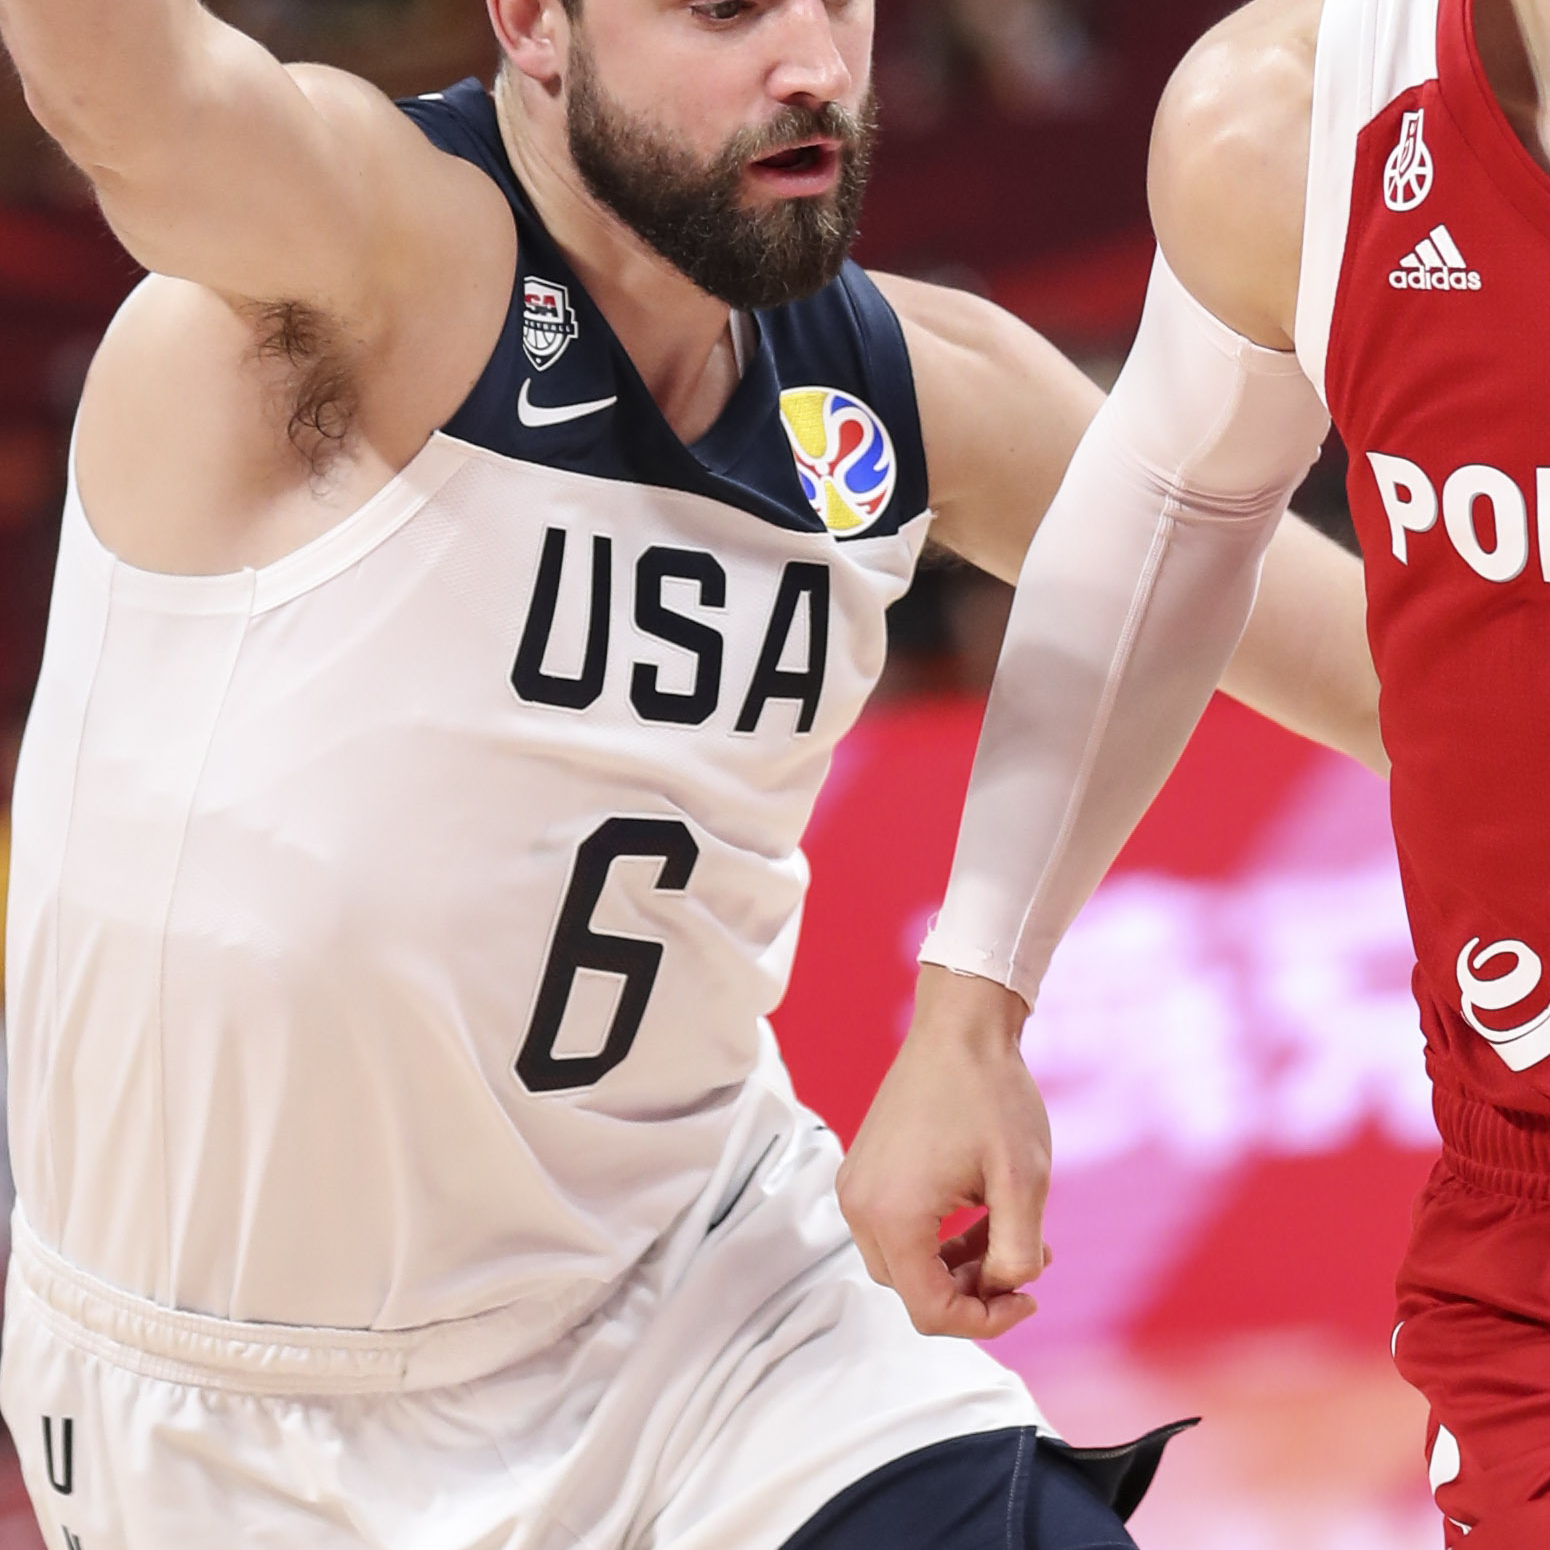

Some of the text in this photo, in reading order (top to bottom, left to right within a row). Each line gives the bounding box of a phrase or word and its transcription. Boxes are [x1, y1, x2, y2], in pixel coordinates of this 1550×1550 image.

[524, 294, 558, 317] SA
[1388, 265, 1482, 291] adidas
[509, 526, 831, 737] USA
[513, 815, 700, 1095] 6
